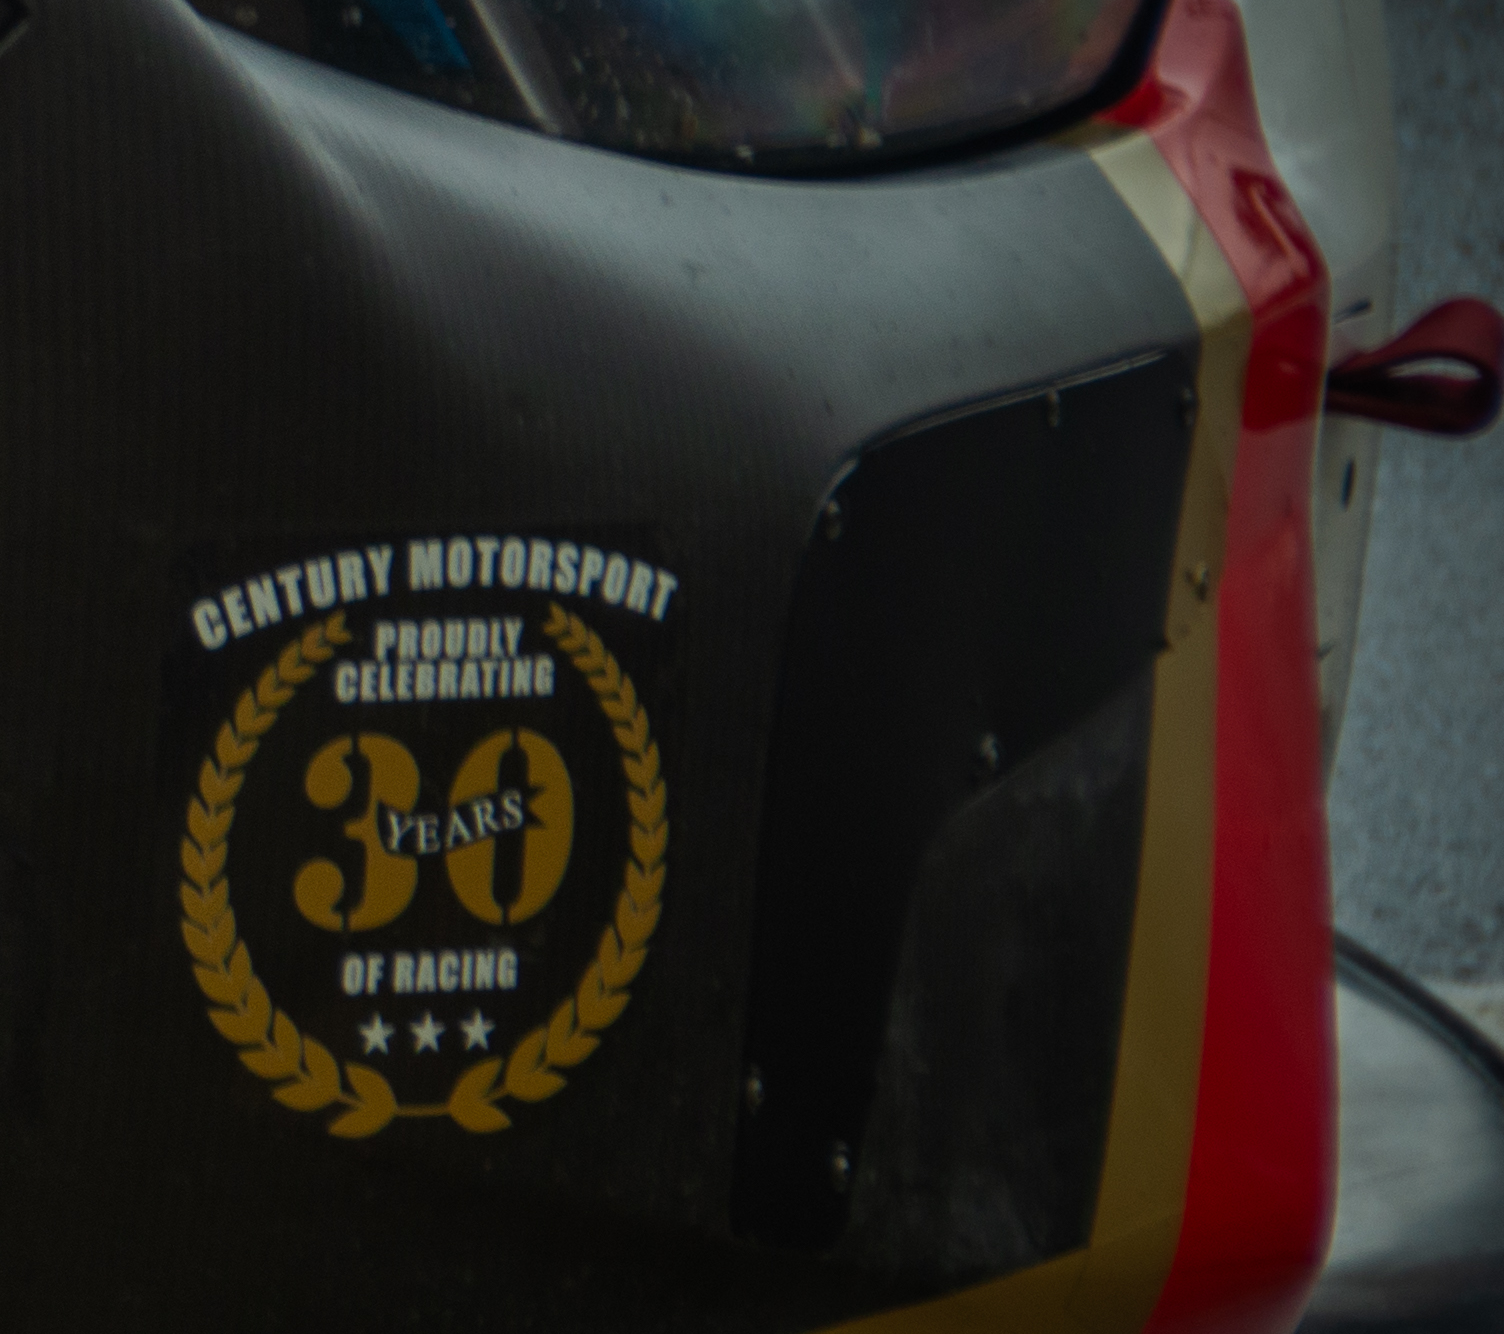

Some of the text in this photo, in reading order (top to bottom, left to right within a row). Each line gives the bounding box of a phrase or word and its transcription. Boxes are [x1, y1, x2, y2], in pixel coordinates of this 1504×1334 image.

[190, 534, 679, 652] CENTURY MOTORSPORT
[373, 616, 525, 661] PROUDLY
[334, 656, 555, 703] CELEBRATING
[292, 728, 575, 934] 30
[385, 789, 525, 855] YEARS
[341, 948, 519, 994] OF RACING
